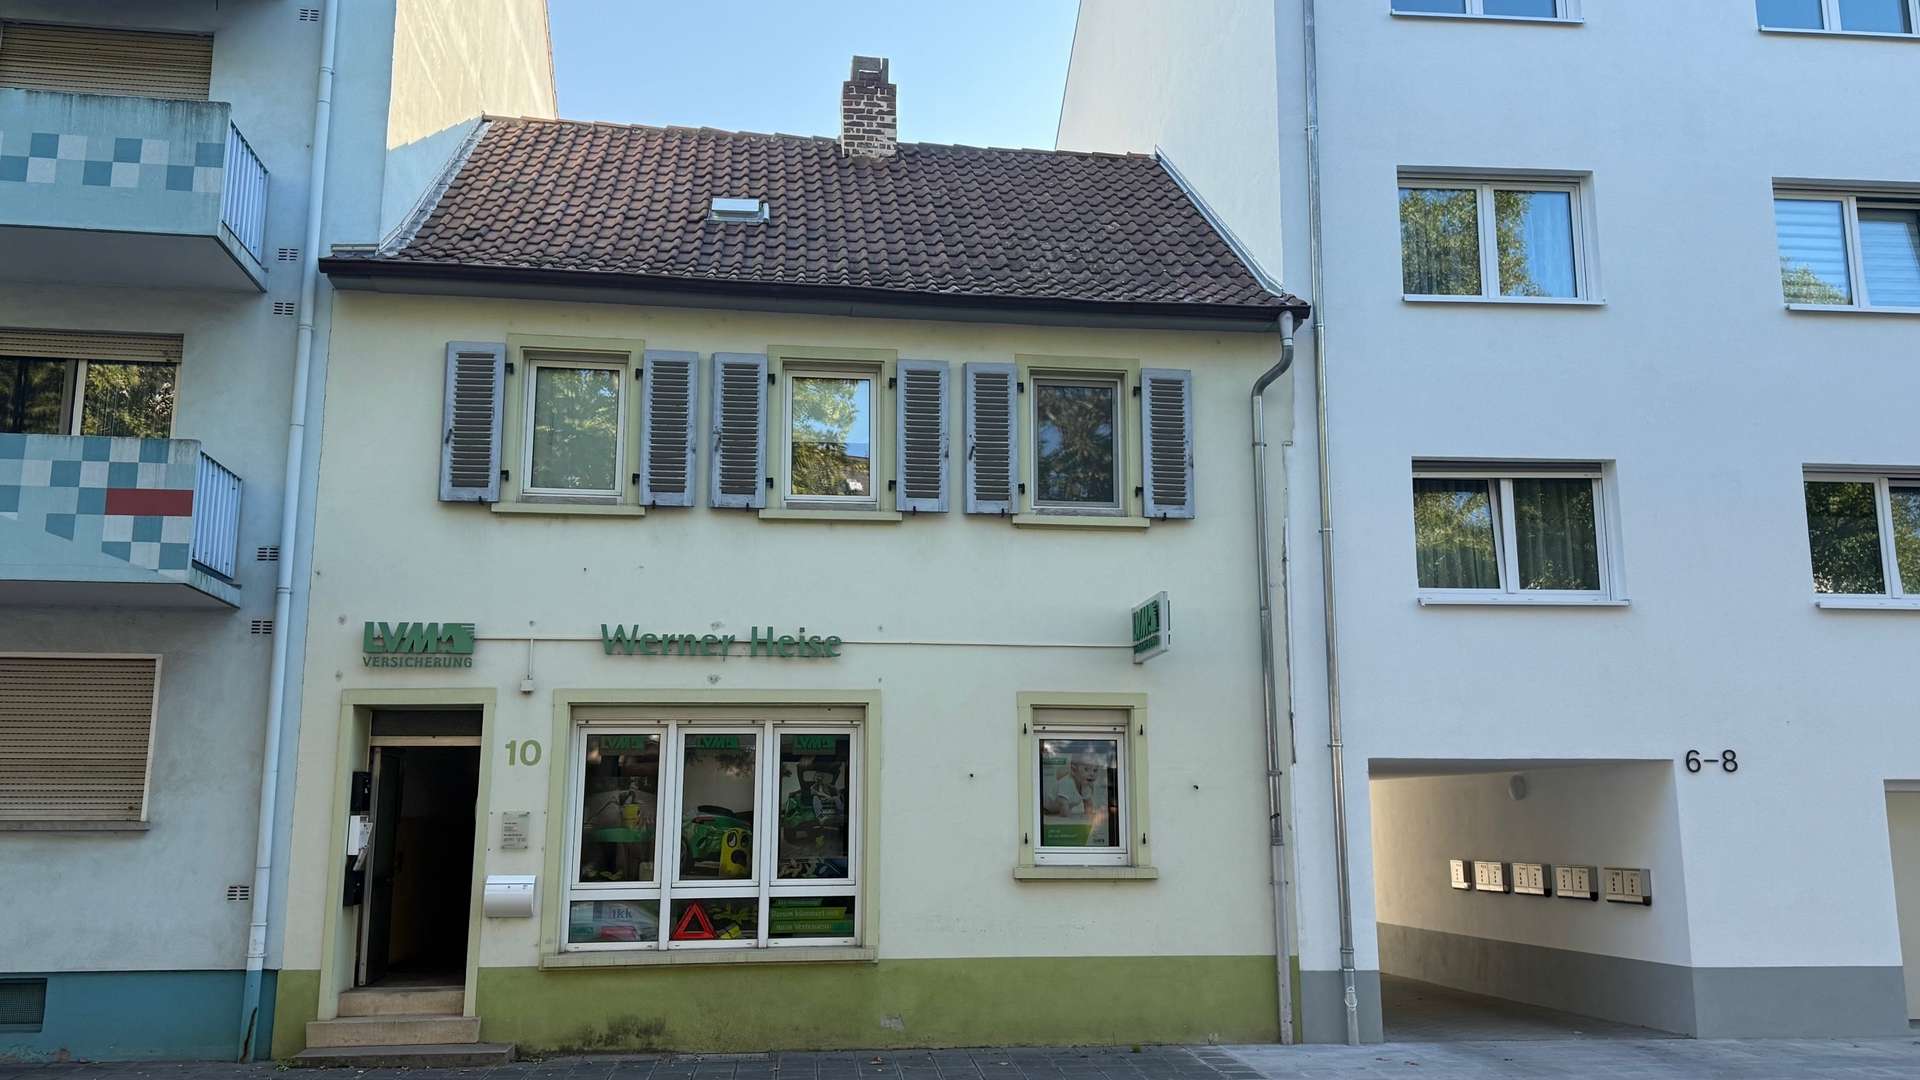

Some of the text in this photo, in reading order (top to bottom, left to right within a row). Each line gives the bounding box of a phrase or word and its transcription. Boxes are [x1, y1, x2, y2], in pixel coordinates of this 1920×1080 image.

[363, 621, 441, 654] LVM
[600, 623, 842, 657] Werner Heise
[363, 656, 473, 668] VERSICHERUNG
[505, 739, 542, 766] 10
[1685, 749, 1739, 773] 6-8
